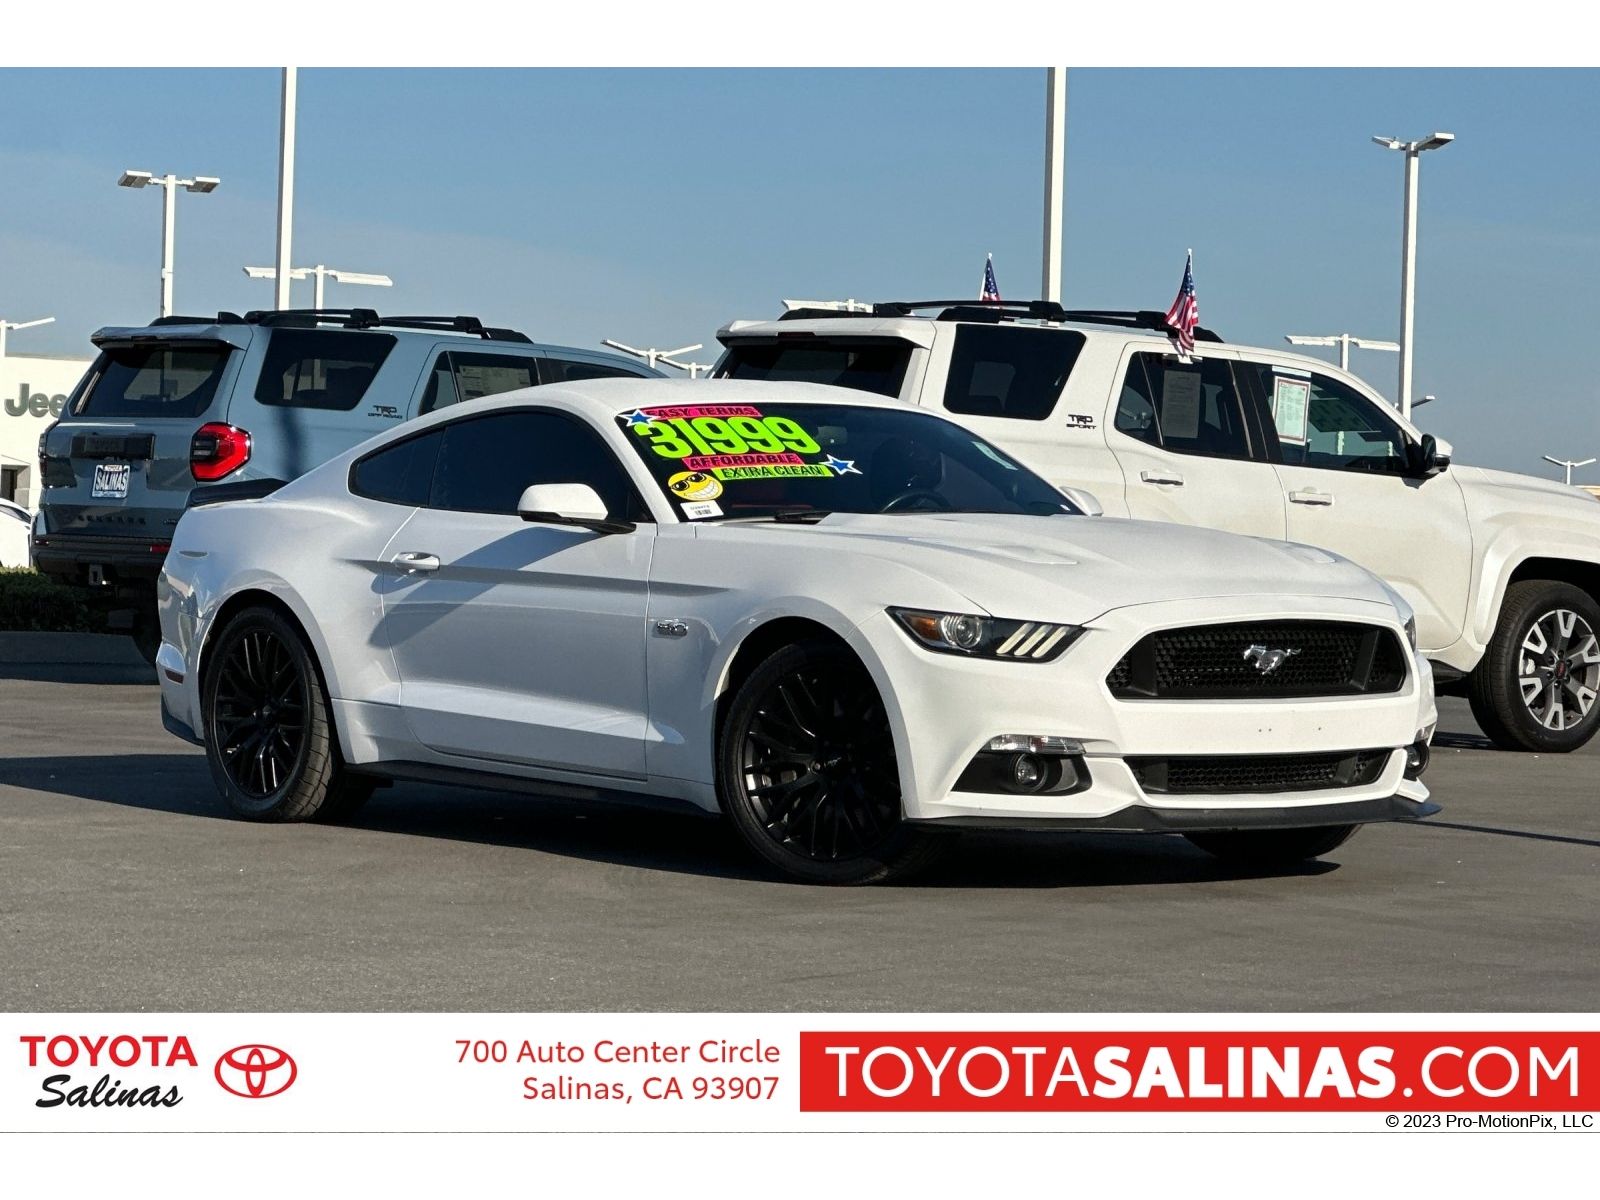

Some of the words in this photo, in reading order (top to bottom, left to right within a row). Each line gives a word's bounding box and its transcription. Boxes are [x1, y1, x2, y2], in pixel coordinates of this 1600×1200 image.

[4, 383, 67, 418] Jee
[373, 405, 397, 413] TRD
[645, 408, 689, 417] EASY
[698, 407, 756, 417] TERMS
[1068, 414, 1093, 424] TRD
[634, 417, 821, 458] 31999
[690, 453, 798, 468] AFFORDABLE
[722, 467, 773, 478] EXTRA
[774, 465, 823, 477] CLEAN
[95, 470, 128, 491] SALINAS
